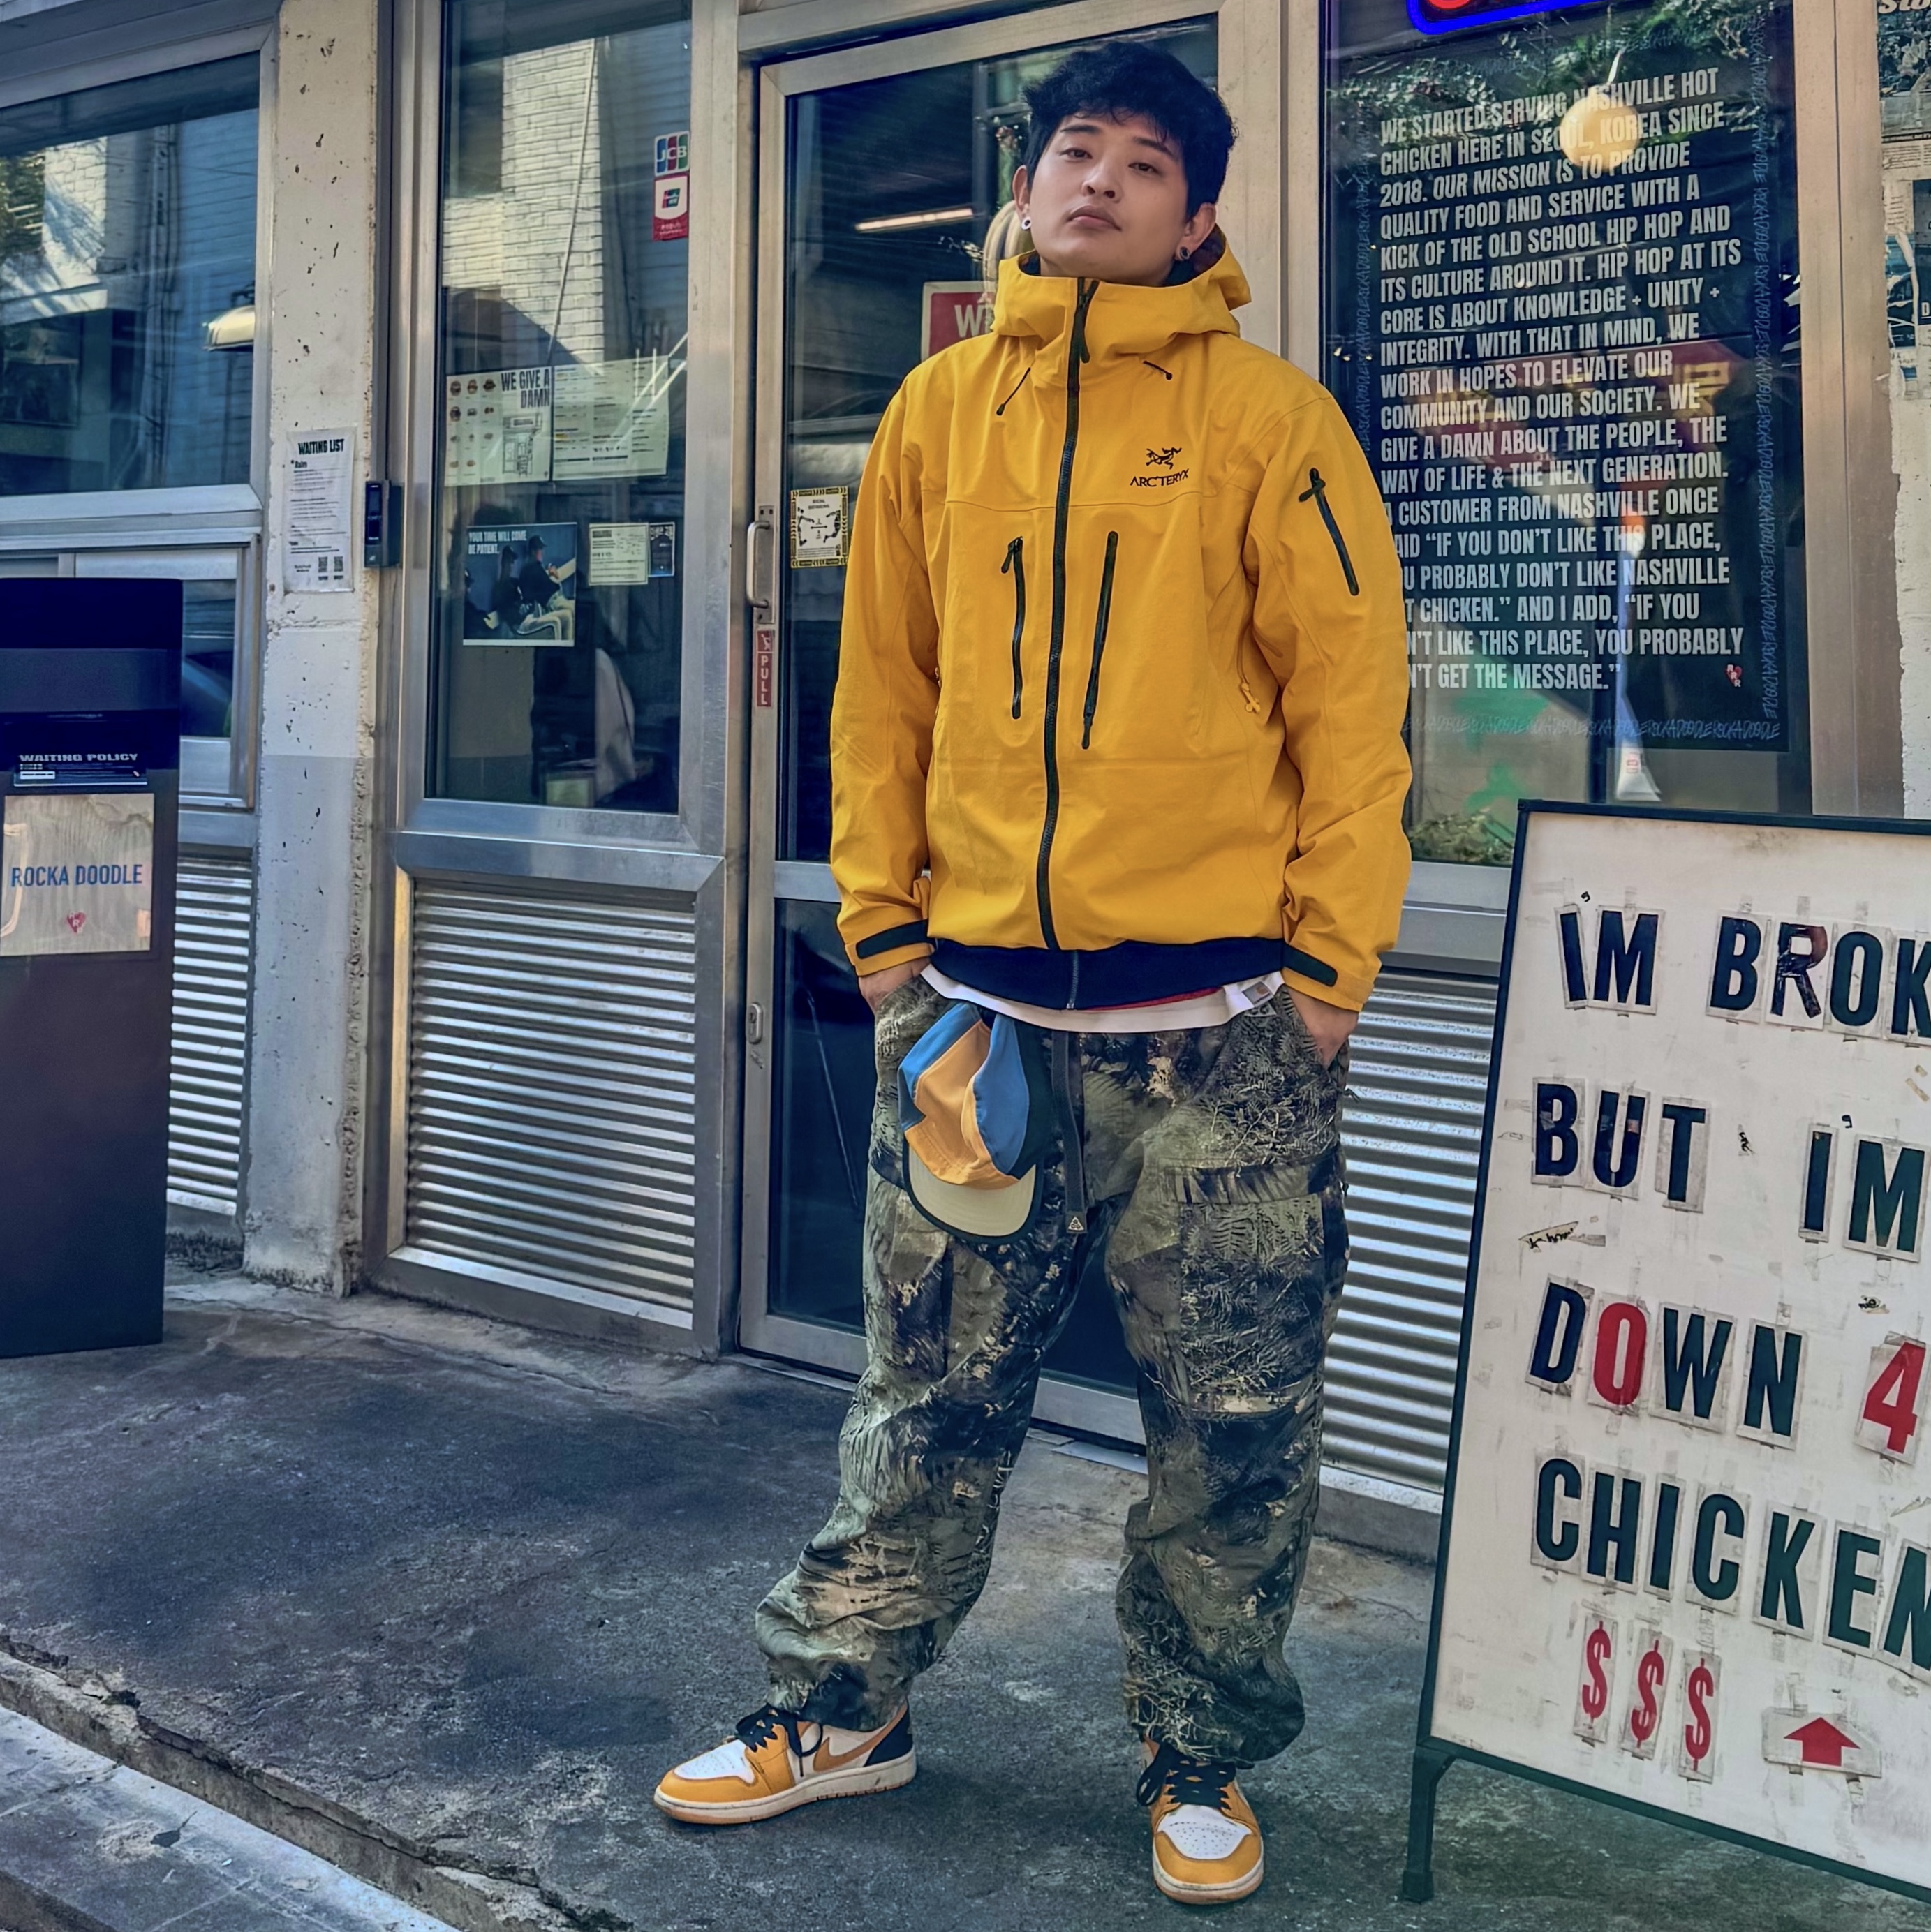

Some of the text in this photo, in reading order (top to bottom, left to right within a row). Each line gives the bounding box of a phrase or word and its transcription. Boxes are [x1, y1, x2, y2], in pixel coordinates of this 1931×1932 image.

[1380, 114, 1407, 146] WE
[1412, 101, 1491, 141] STARTED
[1490, 90, 1567, 128] SERVING
[1573, 74, 1675, 116] NASHVILLE
[1680, 67, 1719, 98] HOT
[657, 146, 687, 162] JCB
[1380, 142, 1453, 177] CHICKEN
[1457, 135, 1502, 165] HERE
[1507, 131, 1525, 158] IN
[1530, 121, 1595, 155] SEOUL,
[1600, 110, 1662, 145] KOREA
[1667, 101, 1725, 135] SINCE
[1380, 177, 1428, 208] 2018.
[1433, 172, 1467, 201] OUR
[1472, 161, 1551, 195] MISSION
[1556, 157, 1574, 184] IS
[1580, 153, 1603, 181] TO
[1608, 141, 1691, 177] PROVIDE
[1380, 173, 1701, 239] QUALITY FOOD AND SERVICE WITH A
[1380, 205, 1731, 272] KICK OF THE OLD SCHOOL HIP HOP AND
[1380, 238, 1743, 304] ITS CULTURE AROUND IT. HIP HOP AT ITS
[1380, 307, 1424, 335] CORE
[1428, 304, 1446, 330] IS
[1451, 298, 1508, 328] ABOUT
[1513, 285, 1627, 322] KNOWLEDGE
[1647, 277, 1705, 309] UNITY
[1380, 313, 1700, 367] INTEGRITY. WITH THAT IN MIND, WE
[501, 369, 549, 391] WE GIVE A
[521, 388, 549, 408] DAMN
[1380, 349, 1673, 399] WORK IN HOPES TO ELEVATE OUR
[1380, 382, 1701, 431] COMMUNITY AND OUR SOCIETY. WE
[298, 438, 345, 455] WAITING LIST
[1380, 435, 1419, 463] GIVE
[1423, 433, 1435, 461] A
[1440, 430, 1495, 459] DAMN
[1500, 426, 1559, 456] ABOUT
[1564, 423, 1600, 452] THE
[1605, 418, 1683, 452] PEOPLE,
[1689, 415, 1728, 445] THE
[1380, 452, 1729, 495] WAY OF LIFE & THE NEXT GENERATION.
[1398, 497, 1492, 525] CUSTOMER
[1497, 494, 1552, 521] FROM
[1557, 489, 1659, 519] NASHVILLE
[1665, 486, 1719, 516] ONCE
[1394, 521, 1722, 558] AID "IF YOU DON'T LIKE THIS PLACE,
[1420, 562, 1511, 589] PROBABLY
[1516, 560, 1571, 588] DON'T
[1576, 559, 1618, 586] LIKE
[1622, 556, 1730, 586] NASHVILLE
[1419, 595, 1511, 622] CHICKEN."
[1516, 594, 1555, 621] AND
[1560, 594, 1567, 621] I
[1571, 593, 1618, 625] ADD,
[1625, 592, 1655, 620] "IF
[1659, 591, 1701, 620] YOU
[1406, 627, 1744, 660] N'T LIKE THIS PLACE, YOU PROBABLY
[760, 655, 769, 705] PULL
[1437, 663, 1470, 690] GET
[1474, 662, 1508, 690] THE
[1512, 662, 1622, 689] MESSAGE."
[10, 865, 144, 887] ROCKA DOODLE
[1709, 914, 1931, 1040] BROK
[1534, 1083, 1706, 1203] BUT
[1529, 1281, 1925, 1455] DOWN 4
[1534, 1457, 1931, 1672] CHICKEN
